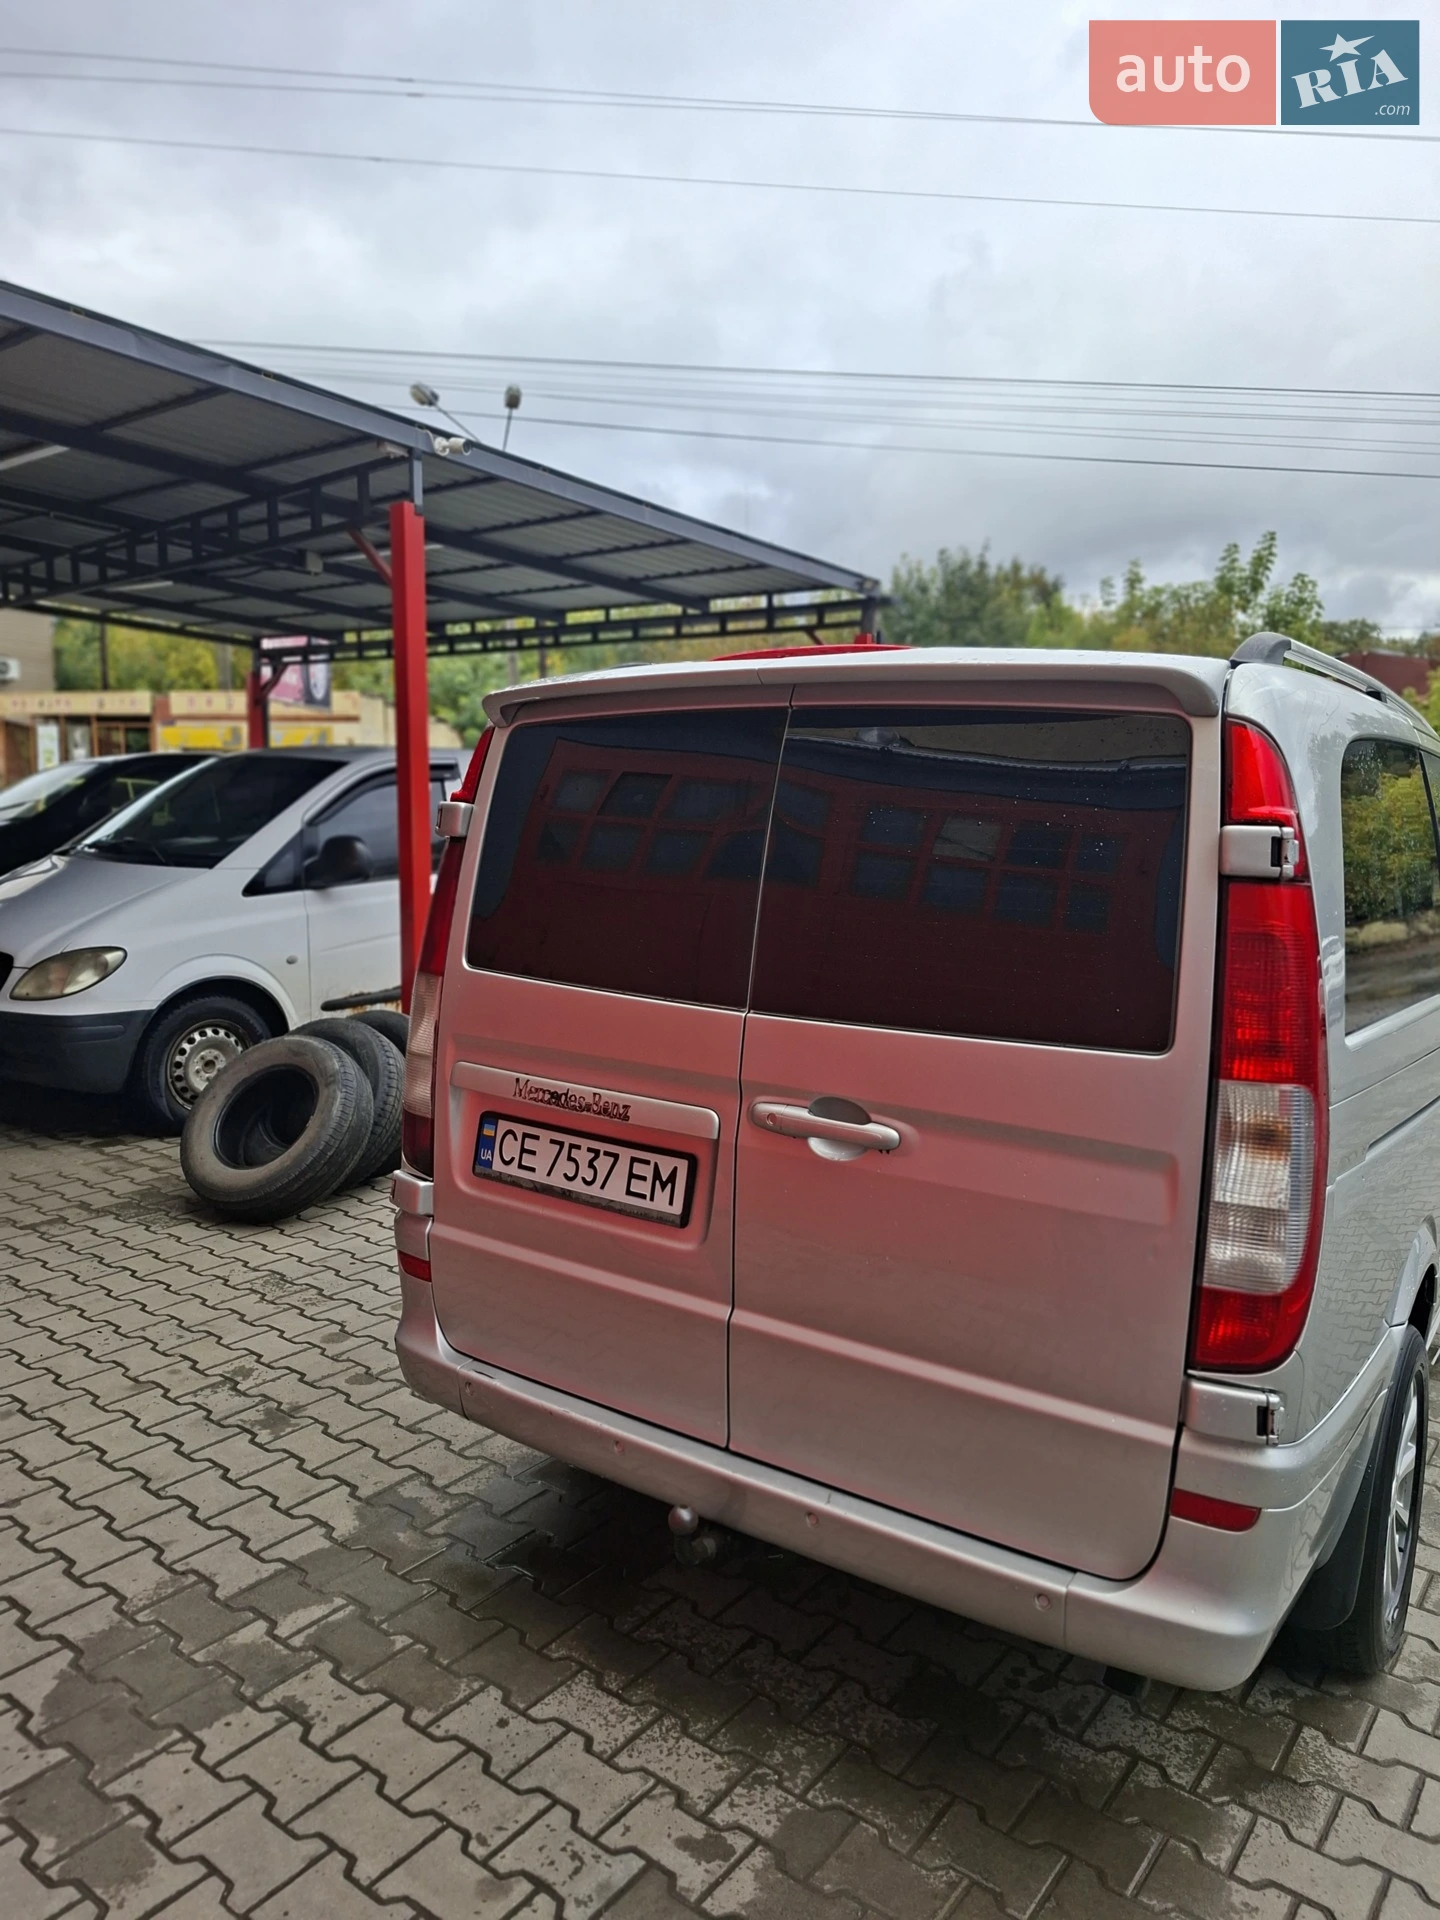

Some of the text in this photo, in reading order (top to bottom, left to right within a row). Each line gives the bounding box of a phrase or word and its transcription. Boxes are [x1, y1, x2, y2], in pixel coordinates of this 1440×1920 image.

[513, 1078, 631, 1121] Mercedes-Benz
[480, 1148, 493, 1162] UA
[498, 1129, 679, 1206] CE 7537 EM
